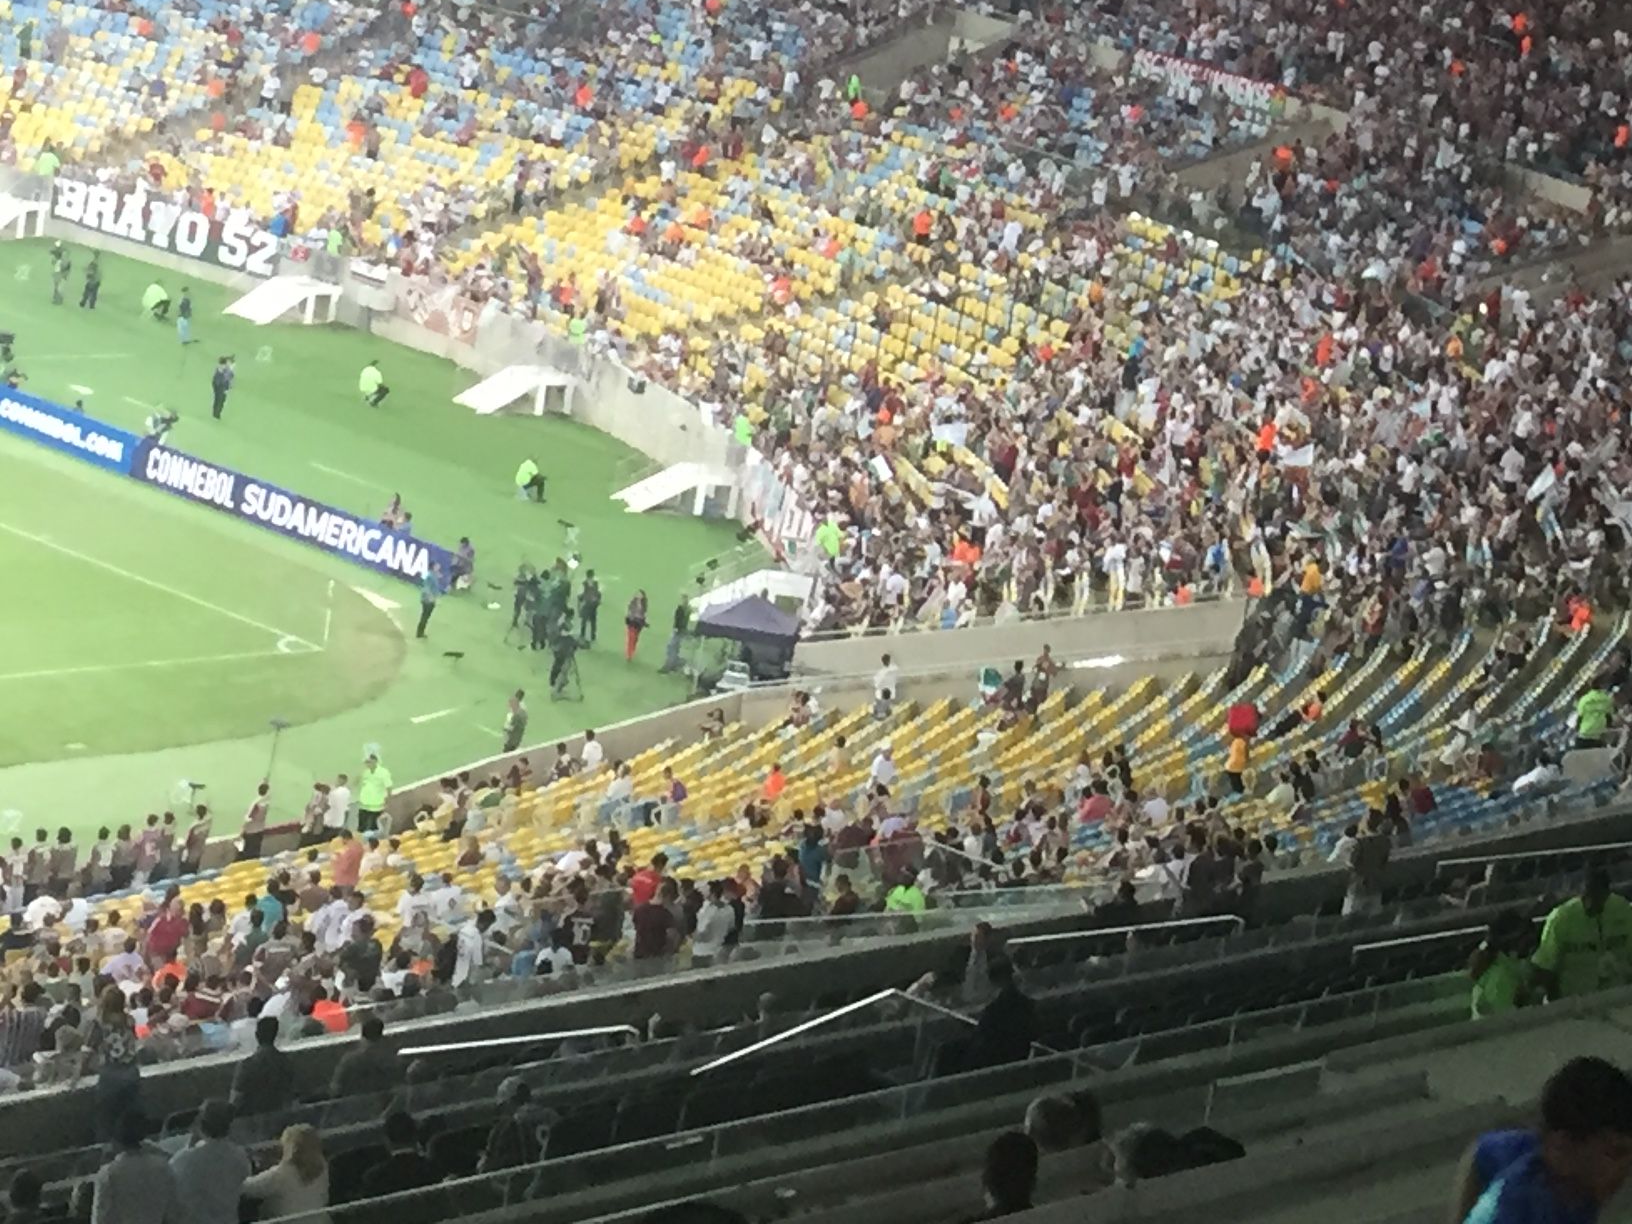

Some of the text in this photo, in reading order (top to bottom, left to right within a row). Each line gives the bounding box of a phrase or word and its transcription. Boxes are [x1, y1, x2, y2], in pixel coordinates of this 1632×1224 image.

[54, 177, 280, 276] BRAVO 52
[146, 447, 430, 579] CONMEBOL SUDAMERICANA
